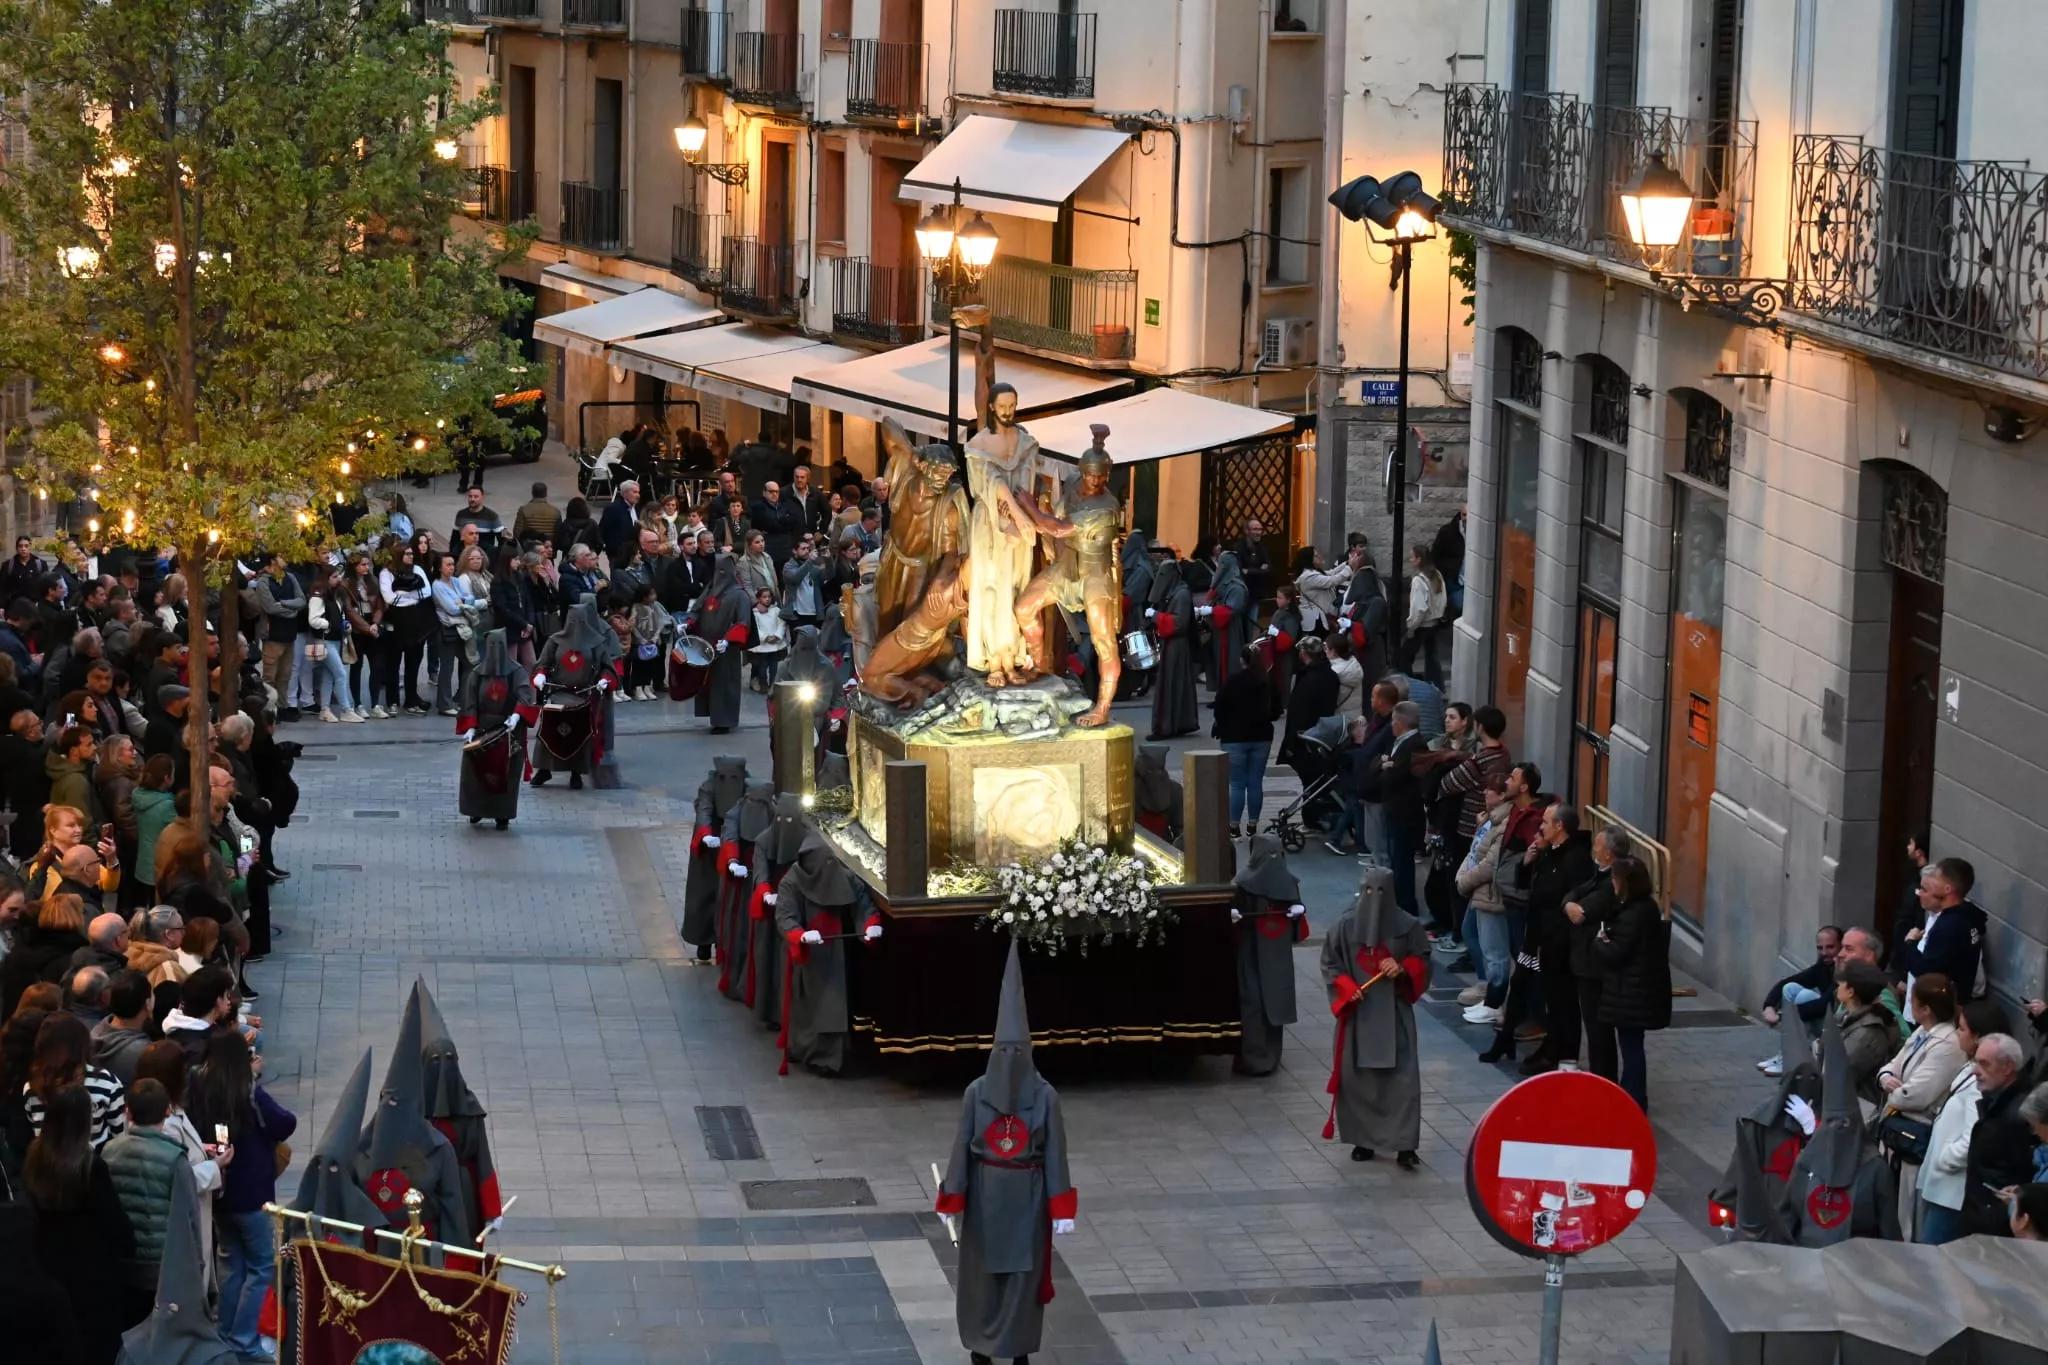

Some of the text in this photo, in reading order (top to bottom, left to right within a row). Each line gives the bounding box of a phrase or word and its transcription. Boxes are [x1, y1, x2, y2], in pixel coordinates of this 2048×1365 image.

[1372, 383, 1395, 391] CALLE
[1363, 396, 1398, 405] SAN ORENC
